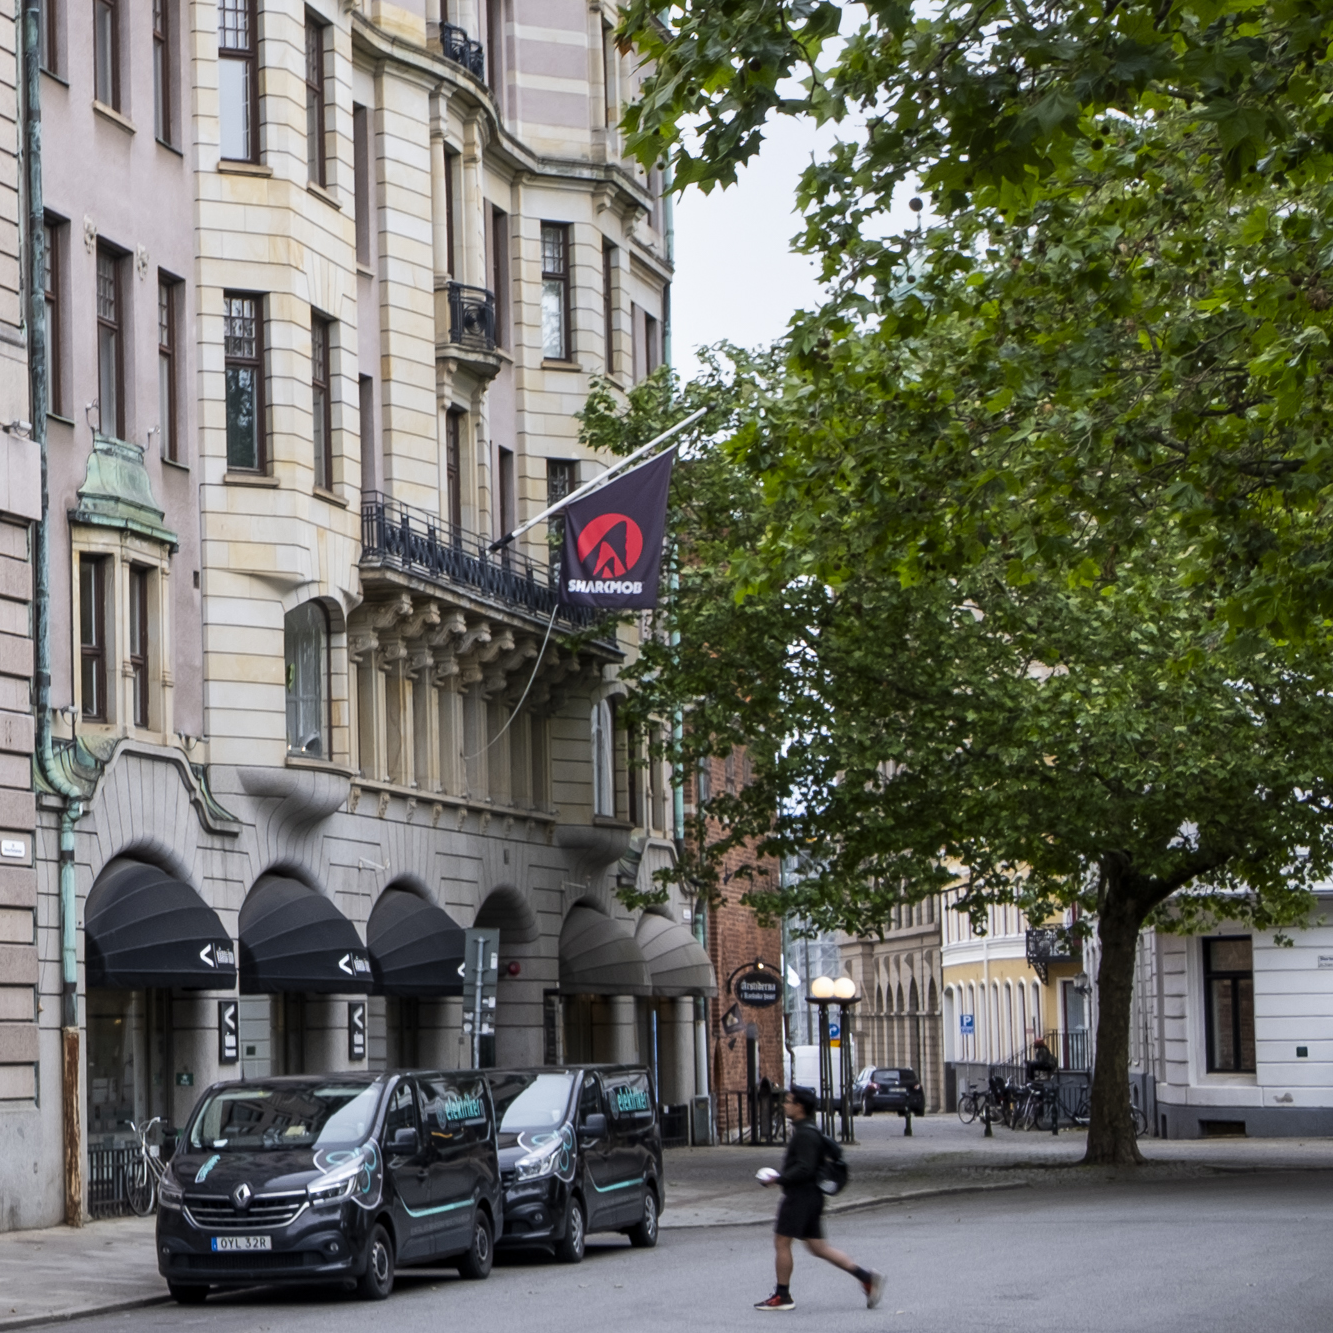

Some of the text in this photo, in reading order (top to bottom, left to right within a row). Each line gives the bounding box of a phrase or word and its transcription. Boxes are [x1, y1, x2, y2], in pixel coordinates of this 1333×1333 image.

[568, 578, 642, 594] SHARKMOB
[963, 1016, 972, 1027] P
[220, 1237, 266, 1249] OYL 32R
